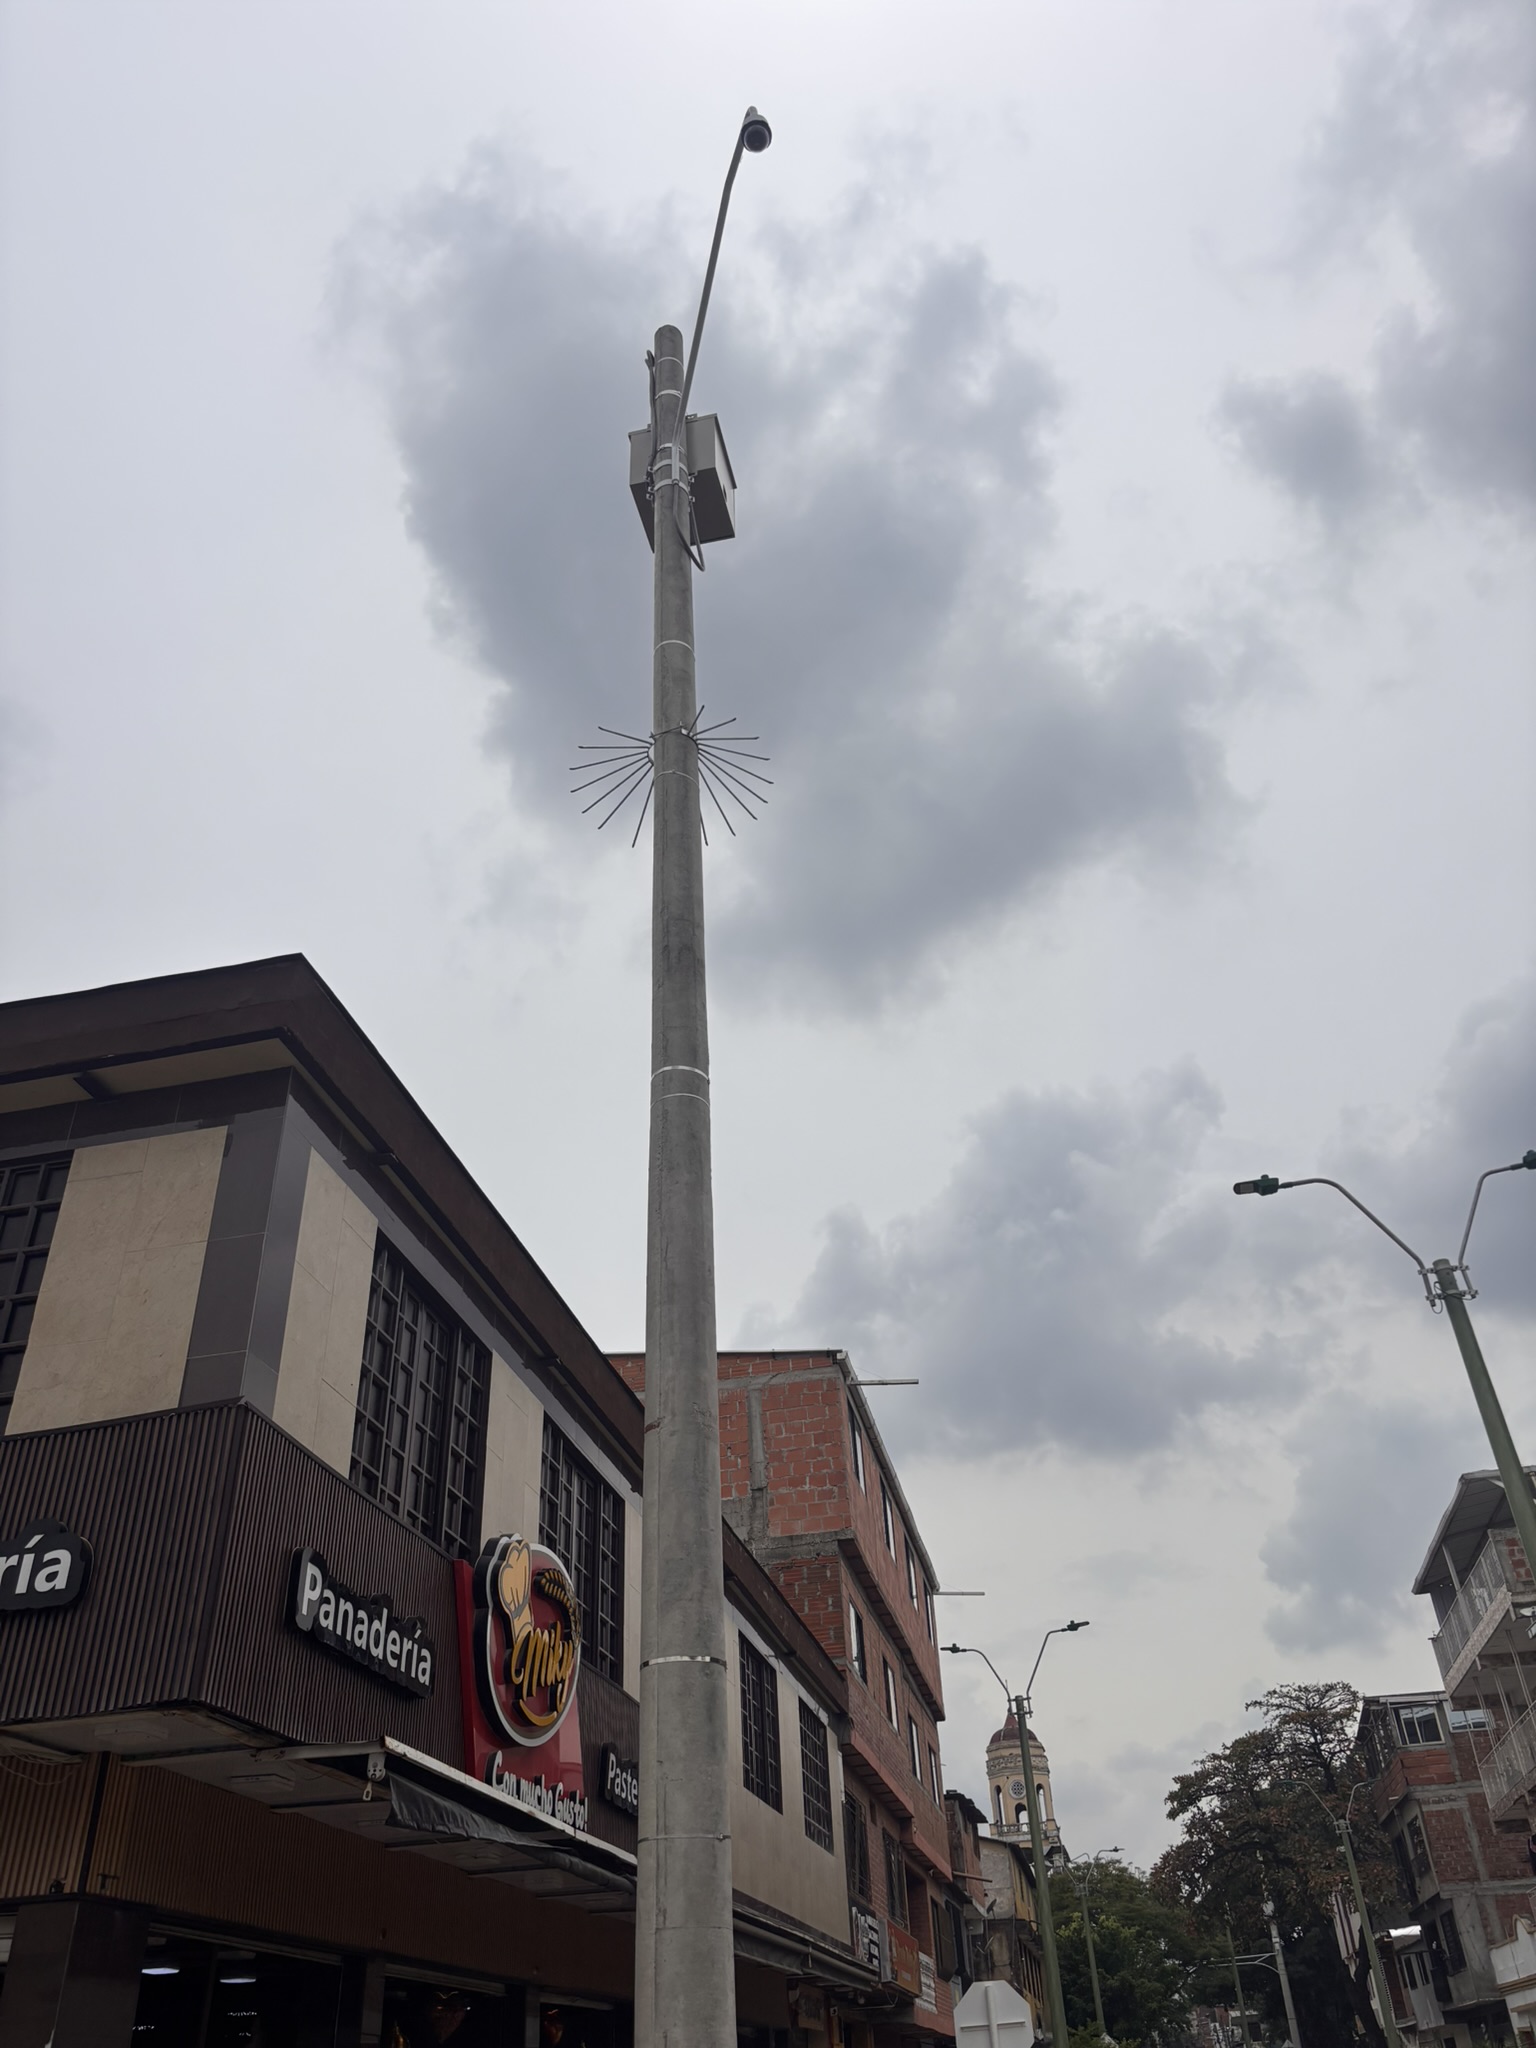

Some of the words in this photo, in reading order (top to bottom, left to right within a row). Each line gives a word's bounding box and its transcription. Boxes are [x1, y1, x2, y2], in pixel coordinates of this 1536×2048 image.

[301, 1562, 431, 1686] Panadería
[511, 1621, 574, 1713] Miky
[492, 1750, 518, 1798] Con
[520, 1774, 553, 1816] mucho
[555, 1782, 588, 1832] Gusto!
[607, 1752, 638, 1806] Paste
